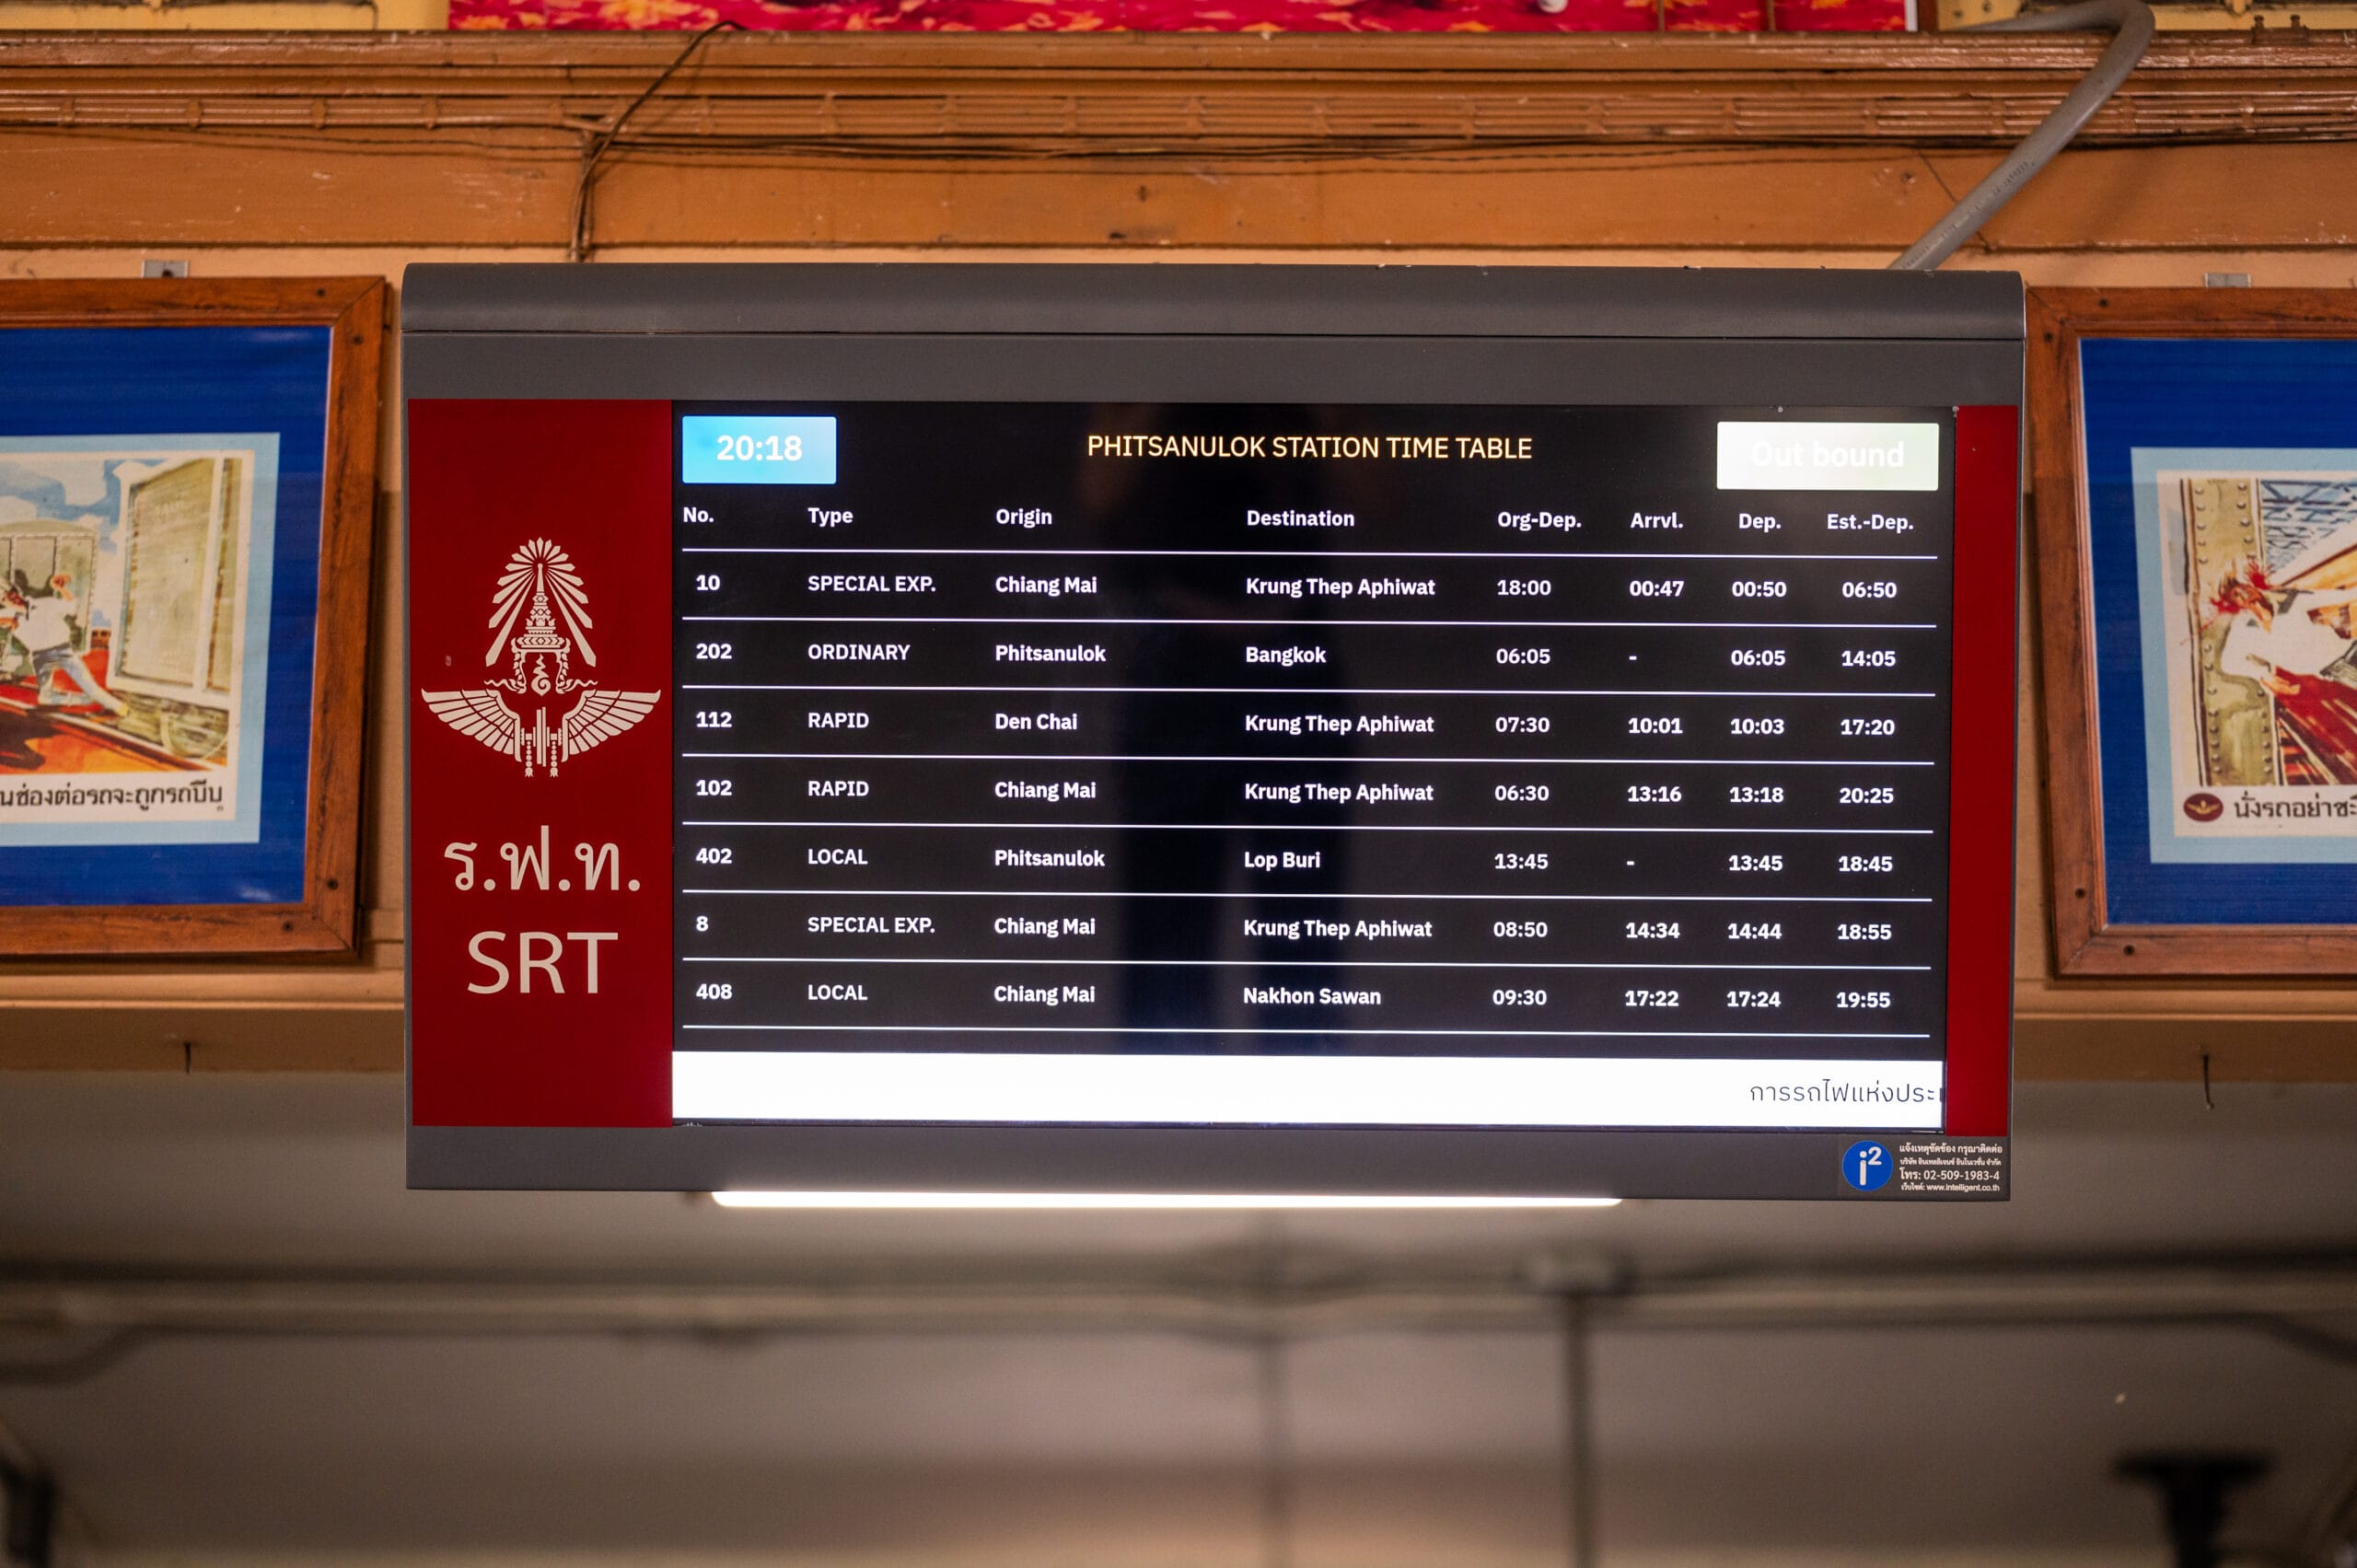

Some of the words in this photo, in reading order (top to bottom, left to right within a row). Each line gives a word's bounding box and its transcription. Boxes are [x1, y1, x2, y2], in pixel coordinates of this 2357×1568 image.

[717, 435, 803, 461] 20:18
[1088, 435, 1266, 458] PHITSANULOK
[1272, 436, 1379, 459] STATION
[1386, 436, 1449, 459] TIME
[1455, 437, 1533, 459] TABLE
[1751, 441, 1805, 468] Out
[1813, 440, 1904, 468] bound
[684, 507, 714, 523] No.
[808, 507, 853, 527] Type
[996, 508, 1051, 528] Origin
[1248, 510, 1354, 527] Destination
[1498, 512, 1581, 532] Org-Dep.
[1631, 512, 1683, 528] Arrvl.
[1739, 514, 1781, 532] Dep.
[1828, 514, 1913, 534] Est.-Dep.
[697, 575, 720, 590] 10
[808, 575, 889, 591] SPECIAL
[896, 576, 935, 592] EXP.
[996, 576, 1060, 597] Chiang
[1065, 576, 1097, 594] Mai
[1247, 578, 1302, 598] Krung
[1306, 578, 1353, 598] Thep
[1358, 578, 1435, 598] Aphiwat
[1498, 580, 1550, 596] 18:00
[1630, 581, 1684, 597] 00:47
[1732, 581, 1786, 597] 00:50
[1842, 582, 1897, 598] 06:50
[696, 644, 732, 659] 202
[808, 645, 910, 660] ORDINARY
[996, 645, 1106, 661] Phitsanulok
[1247, 646, 1326, 667] Bangkok
[1497, 648, 1550, 664] 06:05
[1731, 650, 1785, 666] 06:05
[1841, 651, 1896, 667] 14:05
[696, 712, 732, 727] 112
[808, 713, 869, 728] RAPID
[996, 714, 1031, 730] Den
[1037, 714, 1077, 730] Chai
[1246, 715, 1301, 735] Krung
[1306, 715, 1352, 735] Thep
[1357, 715, 1434, 736] Aphiwat
[1496, 717, 1550, 733] 07:30
[1629, 718, 1683, 734] 10:01
[1731, 718, 1784, 734] 10:03
[1840, 719, 1895, 735] 17:20
[696, 780, 732, 796] 102
[808, 781, 869, 796] RAPID
[995, 782, 1059, 802] Chiang
[1064, 782, 1096, 798] Mai
[1246, 784, 1301, 803] Krung
[1305, 784, 1351, 804] Thep
[1356, 784, 1434, 804] Aphiwat
[1495, 785, 1549, 801] 06:30
[1628, 786, 1681, 802] 13:16
[1730, 787, 1783, 803] 13:18
[1840, 788, 1894, 804] 20:25
[2234, 790, 2357, 819] นั่งรถอย่าชะ
[444, 825, 641, 892] ร.ฟ.ท.
[696, 848, 732, 864] 402
[808, 849, 867, 865] LOCAL
[995, 850, 1105, 866] Phitsanulok
[1245, 852, 1277, 871] Lop
[1283, 852, 1320, 868] Buri
[1495, 854, 1548, 869] 13:45
[1729, 855, 1782, 871] 13:45
[1839, 856, 1893, 872] 18:45
[696, 916, 708, 932] 8
[808, 917, 889, 933] SPECIAL
[895, 917, 935, 933] EXP.
[995, 917, 1059, 938] Chiang
[1063, 918, 1096, 935] Mai
[1245, 920, 1300, 939] Krung
[1304, 920, 1350, 940] Thep
[1355, 920, 1432, 940] Aphiwat
[1493, 922, 1548, 937] 08:50
[1626, 923, 1680, 938] 14:34
[1728, 923, 1782, 939] 14:44
[1838, 924, 1891, 940] 18:55
[467, 931, 619, 994] SRT
[696, 983, 732, 999] 408
[808, 984, 867, 1000] LOCAL
[994, 985, 1059, 1006] Chiang
[1063, 986, 1095, 1003] Mai
[1244, 987, 1314, 1005] Nakhon
[1319, 988, 1381, 1005] Sawan
[1492, 990, 1547, 1005] 09:30
[1625, 991, 1678, 1006] 17:22
[1727, 992, 1781, 1007] 17:24
[1837, 993, 1890, 1008] 19:55
[1750, 1078, 1944, 1103] การรถไฟแห่งประ
[1957, 1144, 2003, 1156] กรุณาติดต่อ
[1899, 1167, 1922, 1180] โทร:
[1923, 1170, 2000, 1180] 02-509-1983-4
[1926, 1183, 2000, 1192] www.intelligent.co.th
